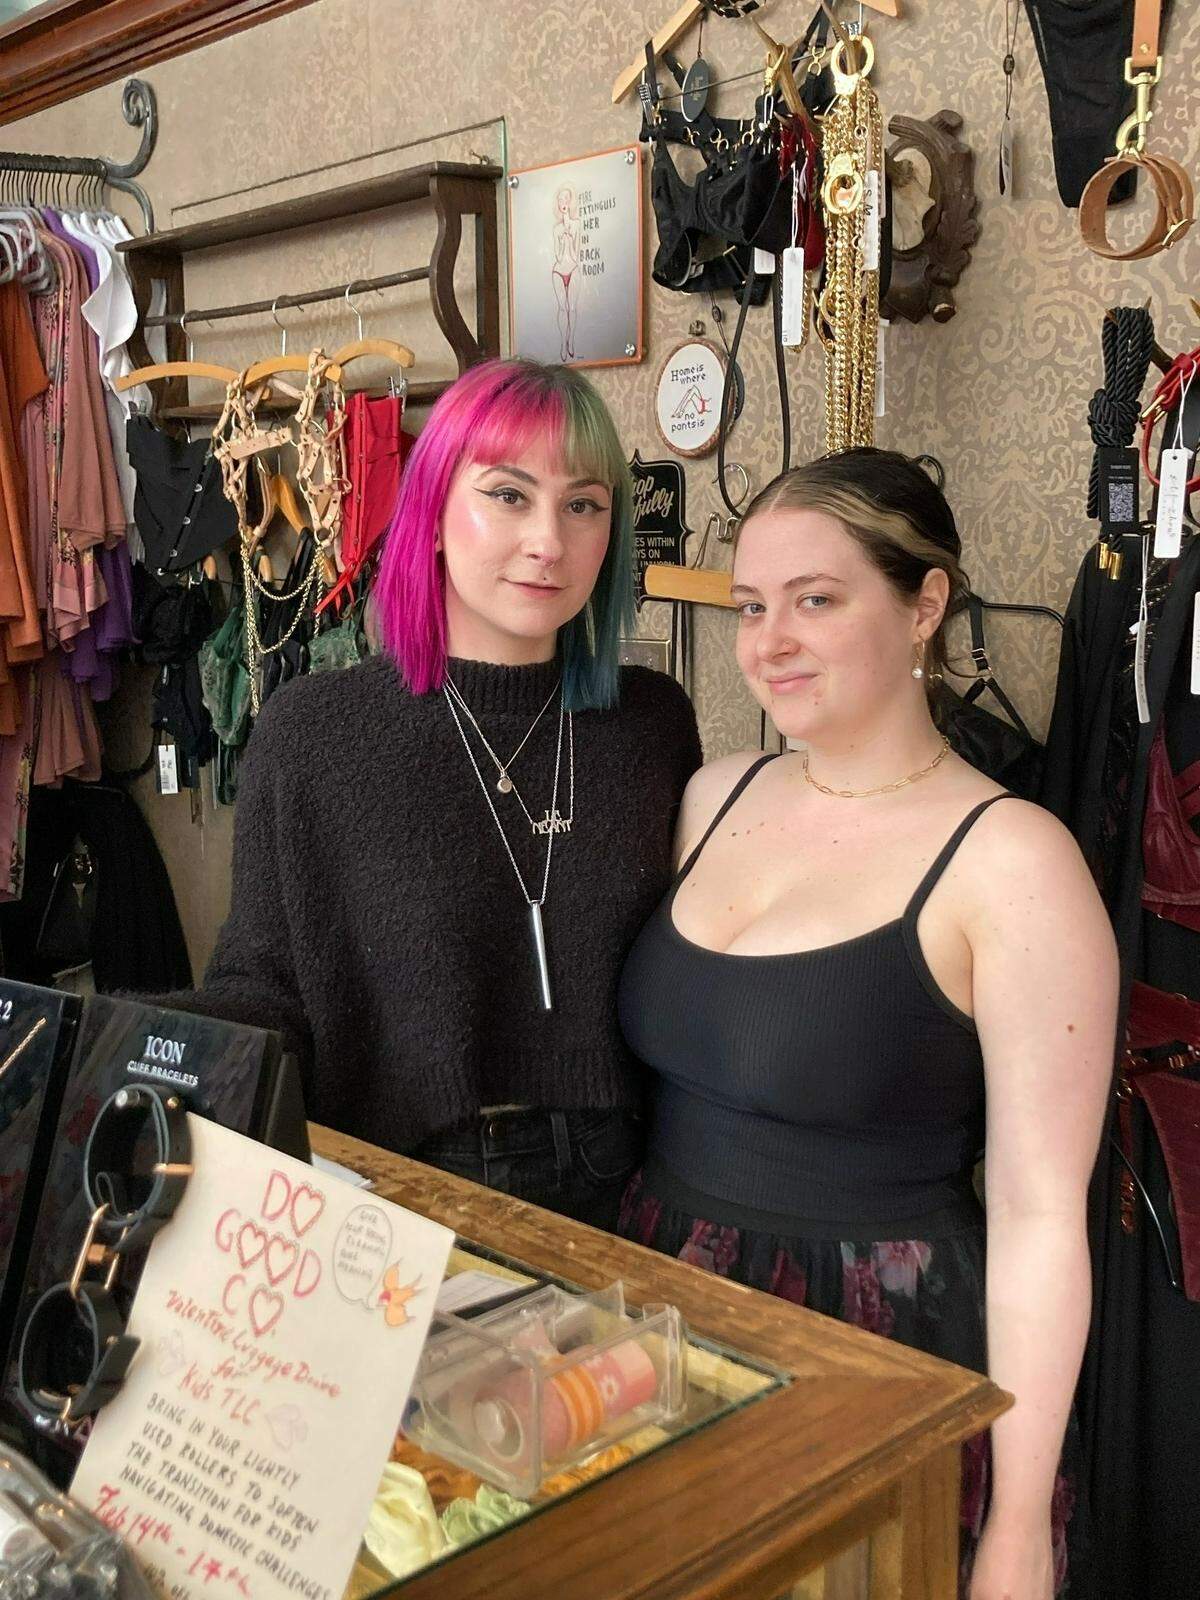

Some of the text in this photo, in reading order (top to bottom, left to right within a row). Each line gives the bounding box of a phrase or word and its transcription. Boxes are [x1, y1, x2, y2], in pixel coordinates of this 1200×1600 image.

[578, 197, 616, 217] EXTINGUIS
[583, 216, 600, 231] HER
[581, 234, 589, 245] IN
[580, 247, 600, 262] BACK
[582, 261, 605, 276] ROOM
[671, 363, 704, 382] Home is
[680, 373, 706, 385] where
[684, 412, 695, 421] no
[646, 536, 675, 547] WITHIN
[648, 549, 660, 559] ON
[143, 1035, 187, 1065] ICON
[150, 1065, 199, 1087] BRACELETS
[177, 1359, 262, 1426] Kids TLC
[146, 1392, 301, 1491] BRING IN YOUR LIGHTLY
[143, 1421, 319, 1534] USED ROLLERS TO SOFTEN
[127, 1440, 302, 1551] THE TRANSITION FOR KIDS
[119, 1463, 195, 1523] NAVIGATING
[200, 1512, 253, 1557] DOMESTIC
